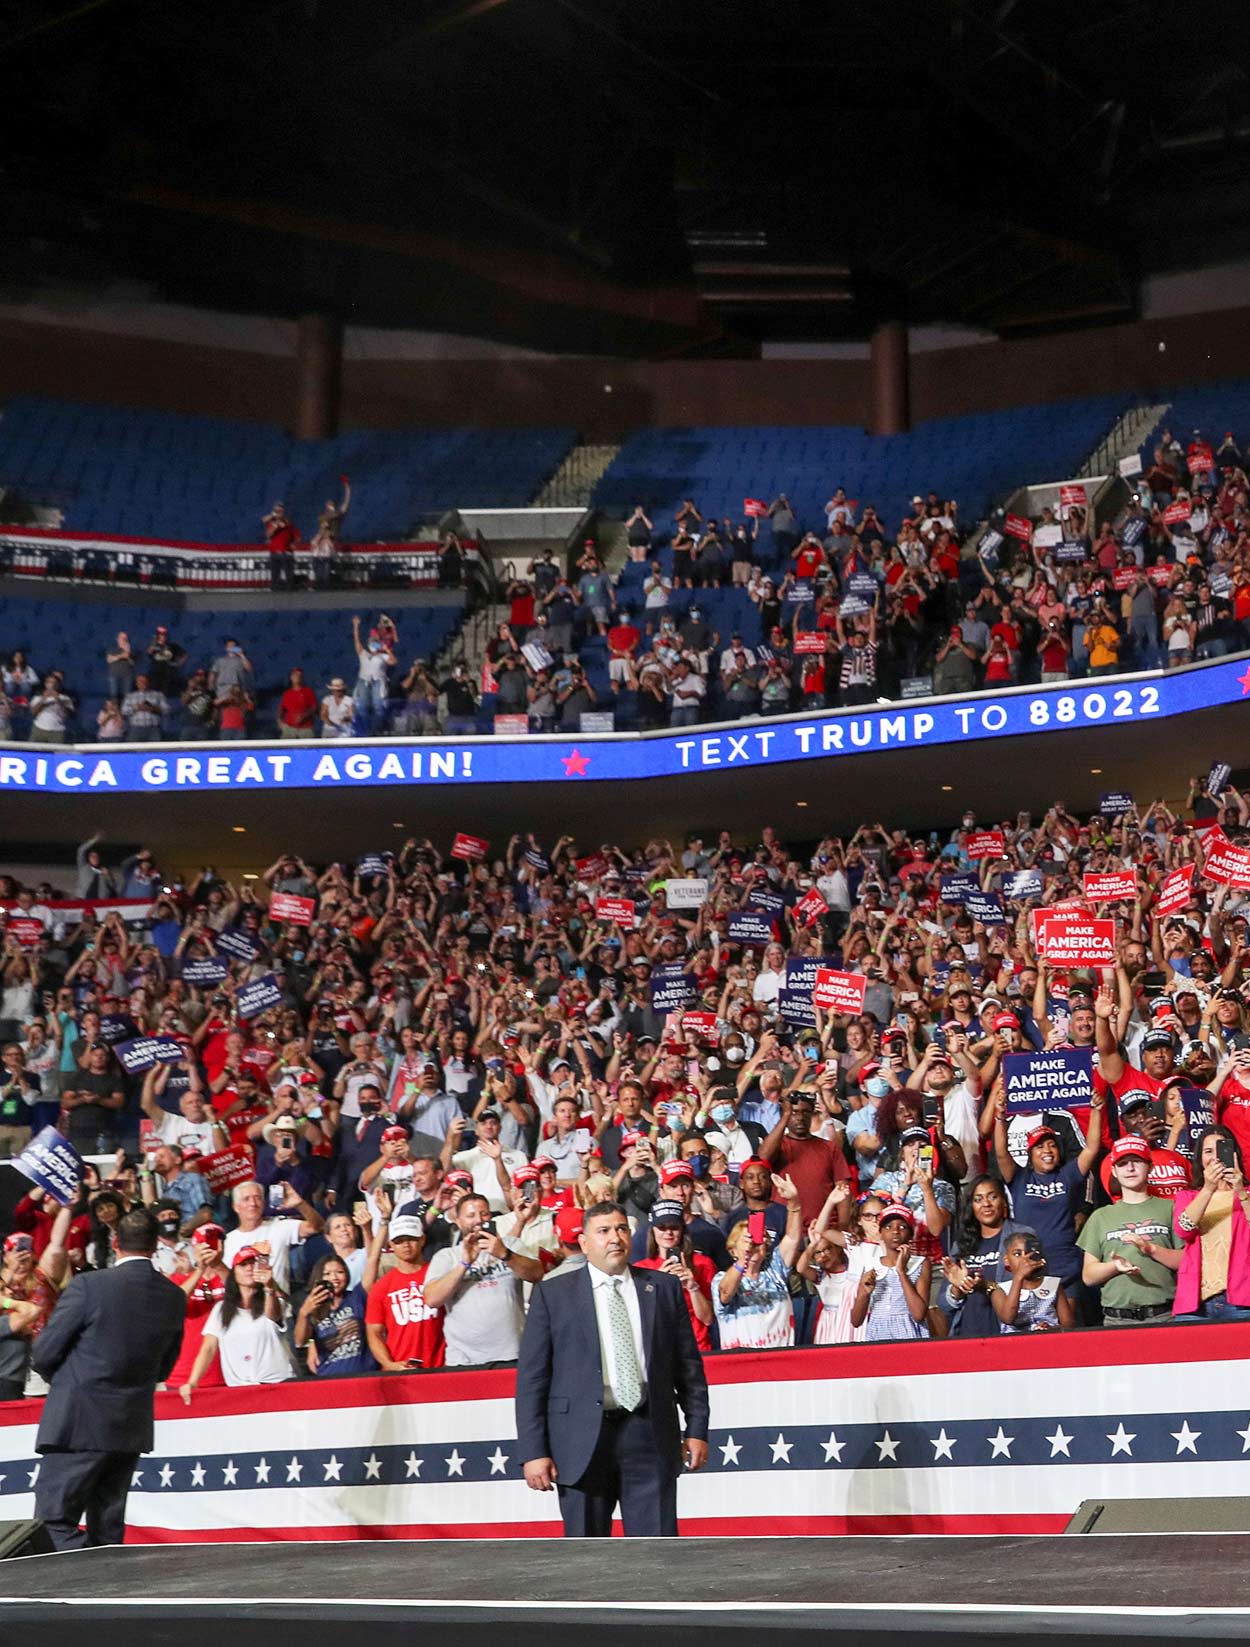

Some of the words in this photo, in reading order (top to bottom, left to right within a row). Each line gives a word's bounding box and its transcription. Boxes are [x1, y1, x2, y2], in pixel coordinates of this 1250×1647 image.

[675, 731, 776, 768] TEXT
[795, 713, 934, 754] TRUMP
[955, 704, 1008, 734] TO
[1029, 686, 1160, 726] 88022
[141, 756, 292, 784] GREAT
[312, 751, 474, 781] AGAIN!
[1101, 799, 1133, 807] AMERICA
[968, 839, 1002, 849] AMERICA
[1224, 849, 1249, 864] MAKE
[1206, 863, 1231, 879] GREAT
[1085, 880, 1135, 892] AMERICA
[1099, 876, 1121, 884] MAKE
[1086, 889, 1111, 899] GREAT
[1110, 886, 1136, 897] AGAIN
[1160, 876, 1190, 901] AMERICA
[968, 896, 987, 905] MAKE
[599, 908, 633, 918] AMERICA
[741, 916, 760, 924] MAKE
[728, 922, 771, 933] AMERICA
[1066, 926, 1094, 935] MAKE
[1047, 937, 1113, 949] AMERICA
[1047, 950, 1080, 960] GREAT
[1081, 949, 1114, 959] AGAIN
[181, 965, 227, 976] AMERICA
[803, 963, 827, 971] MAKE
[665, 980, 687, 989] MAKE
[788, 982, 815, 990] GREAT
[828, 975, 849, 986] MAKE
[238, 985, 280, 1008] AMERICA
[653, 988, 697, 1000] AMERICA
[816, 983, 862, 998] AMERICA
[816, 993, 838, 1003] GREAT
[838, 997, 861, 1008] AGAIN
[780, 1008, 801, 1017] GREAT
[683, 1016, 705, 1024] MAKE
[133, 1038, 160, 1050] MAKE
[122, 1041, 184, 1064] AMERICA
[124, 1055, 157, 1069] GREAT
[157, 1048, 184, 1063] AGAIN
[1030, 1058, 1066, 1072] MAKE
[1007, 1070, 1090, 1090] AMERICA
[1008, 1089, 1051, 1103] GREAT
[55, 1143, 80, 1168] MAKE
[213, 1153, 235, 1166] MAKE
[204, 1156, 251, 1180] AMERICA
[390, 1298, 438, 1327] USA
